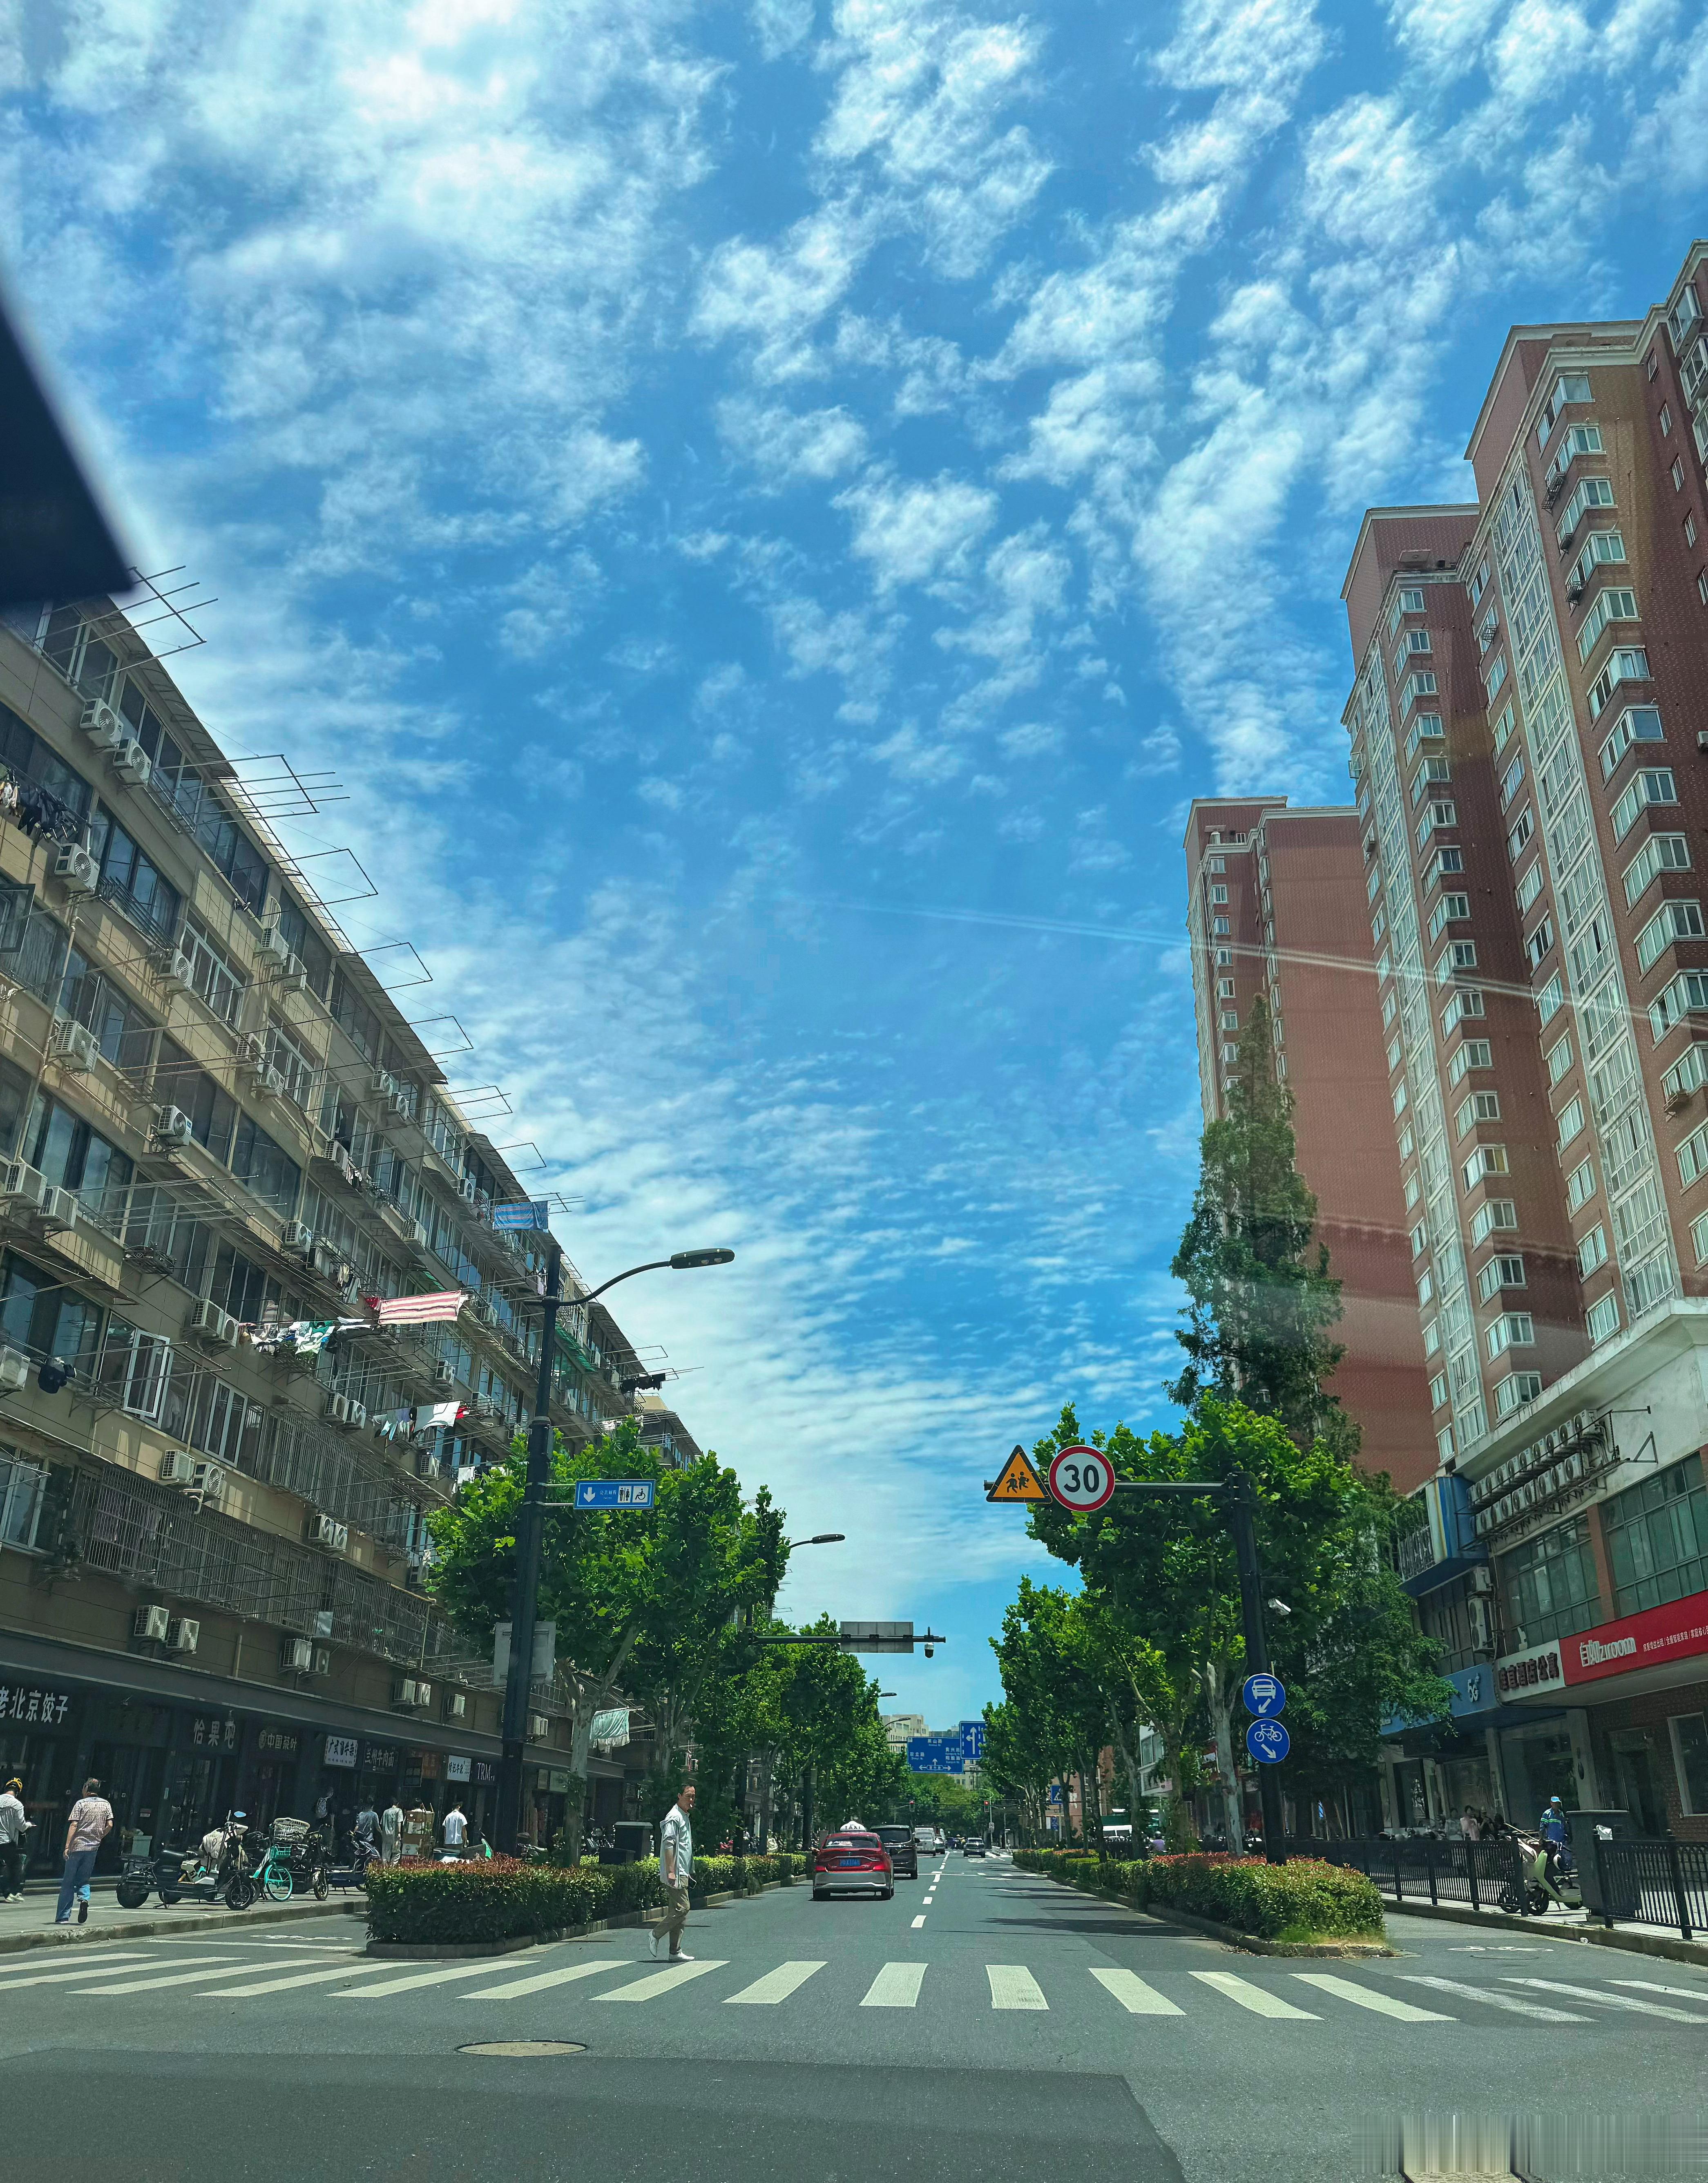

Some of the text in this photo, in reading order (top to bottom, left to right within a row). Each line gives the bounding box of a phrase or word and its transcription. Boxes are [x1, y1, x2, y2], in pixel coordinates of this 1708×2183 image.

[1064, 1464, 1099, 1493] 30
[0, 1686, 69, 1724] 老北京饺子
